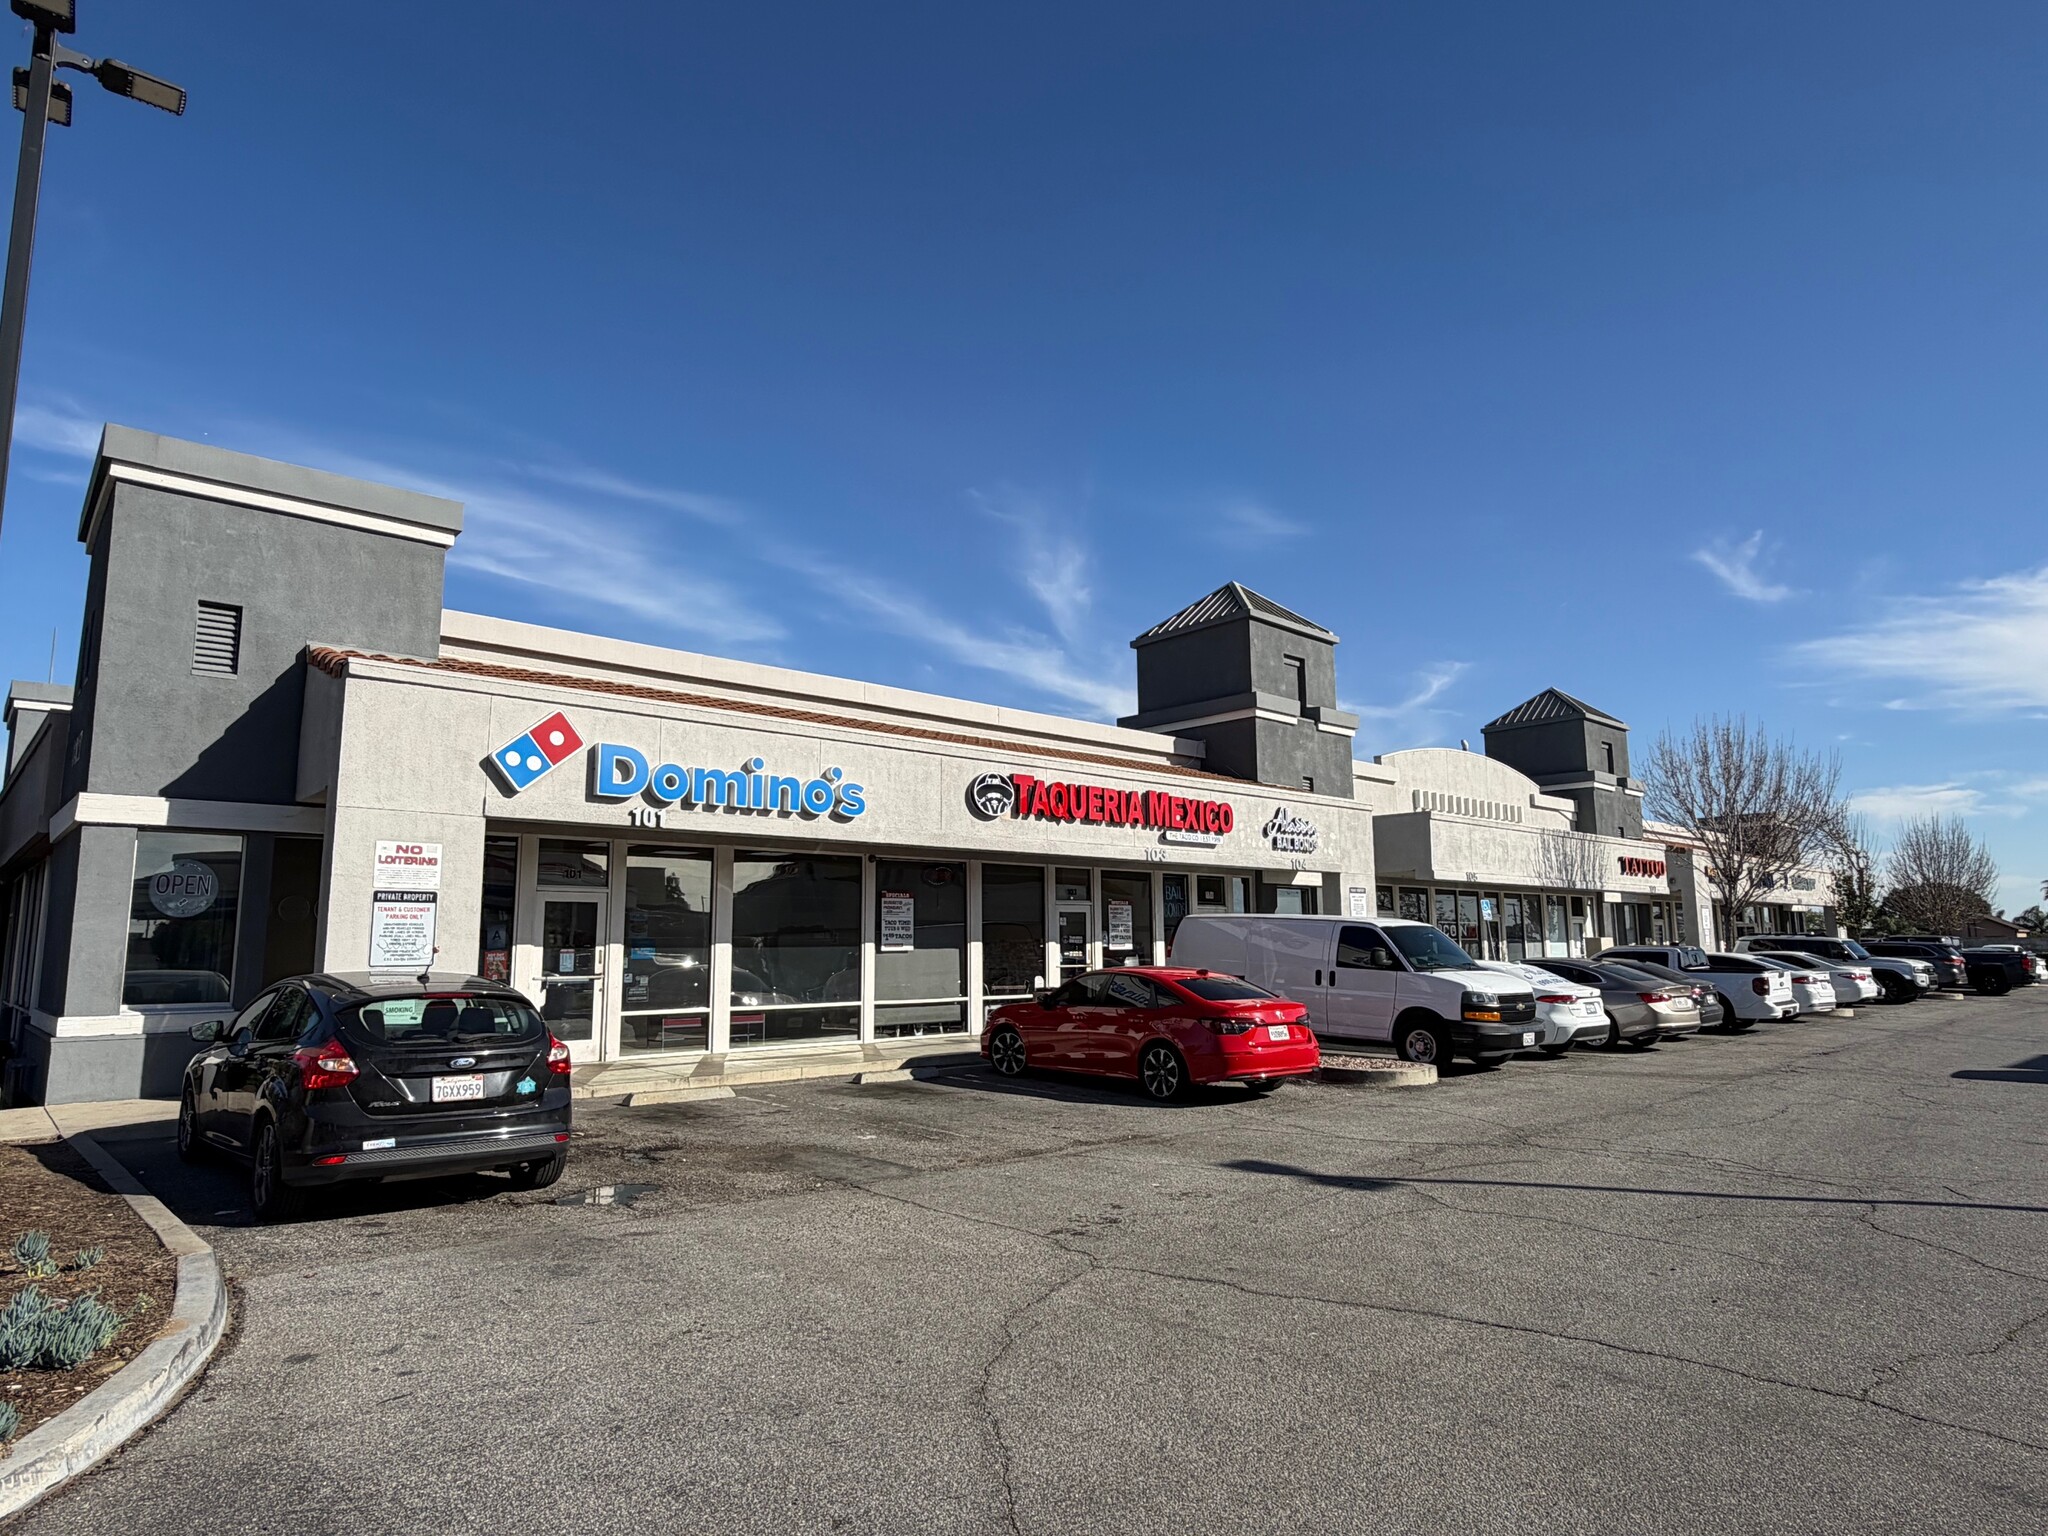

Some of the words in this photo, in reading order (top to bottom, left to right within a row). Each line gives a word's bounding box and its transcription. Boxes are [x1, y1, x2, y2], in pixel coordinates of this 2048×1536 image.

[597, 742, 867, 818] Domino's
[1012, 773, 1145, 826] TAQUERIA
[1150, 790, 1234, 834] MEXICO
[630, 807, 667, 829] 101
[395, 844, 423, 855] NO
[378, 854, 438, 866] LOITERING
[1624, 856, 1667, 877] TATTOO
[155, 873, 212, 896] OPEN
[377, 893, 402, 901] PRIVATE
[403, 893, 434, 901] PROPERTY
[385, 1006, 413, 1014] SMOKING
[435, 1083, 482, 1099] 7GXX959
